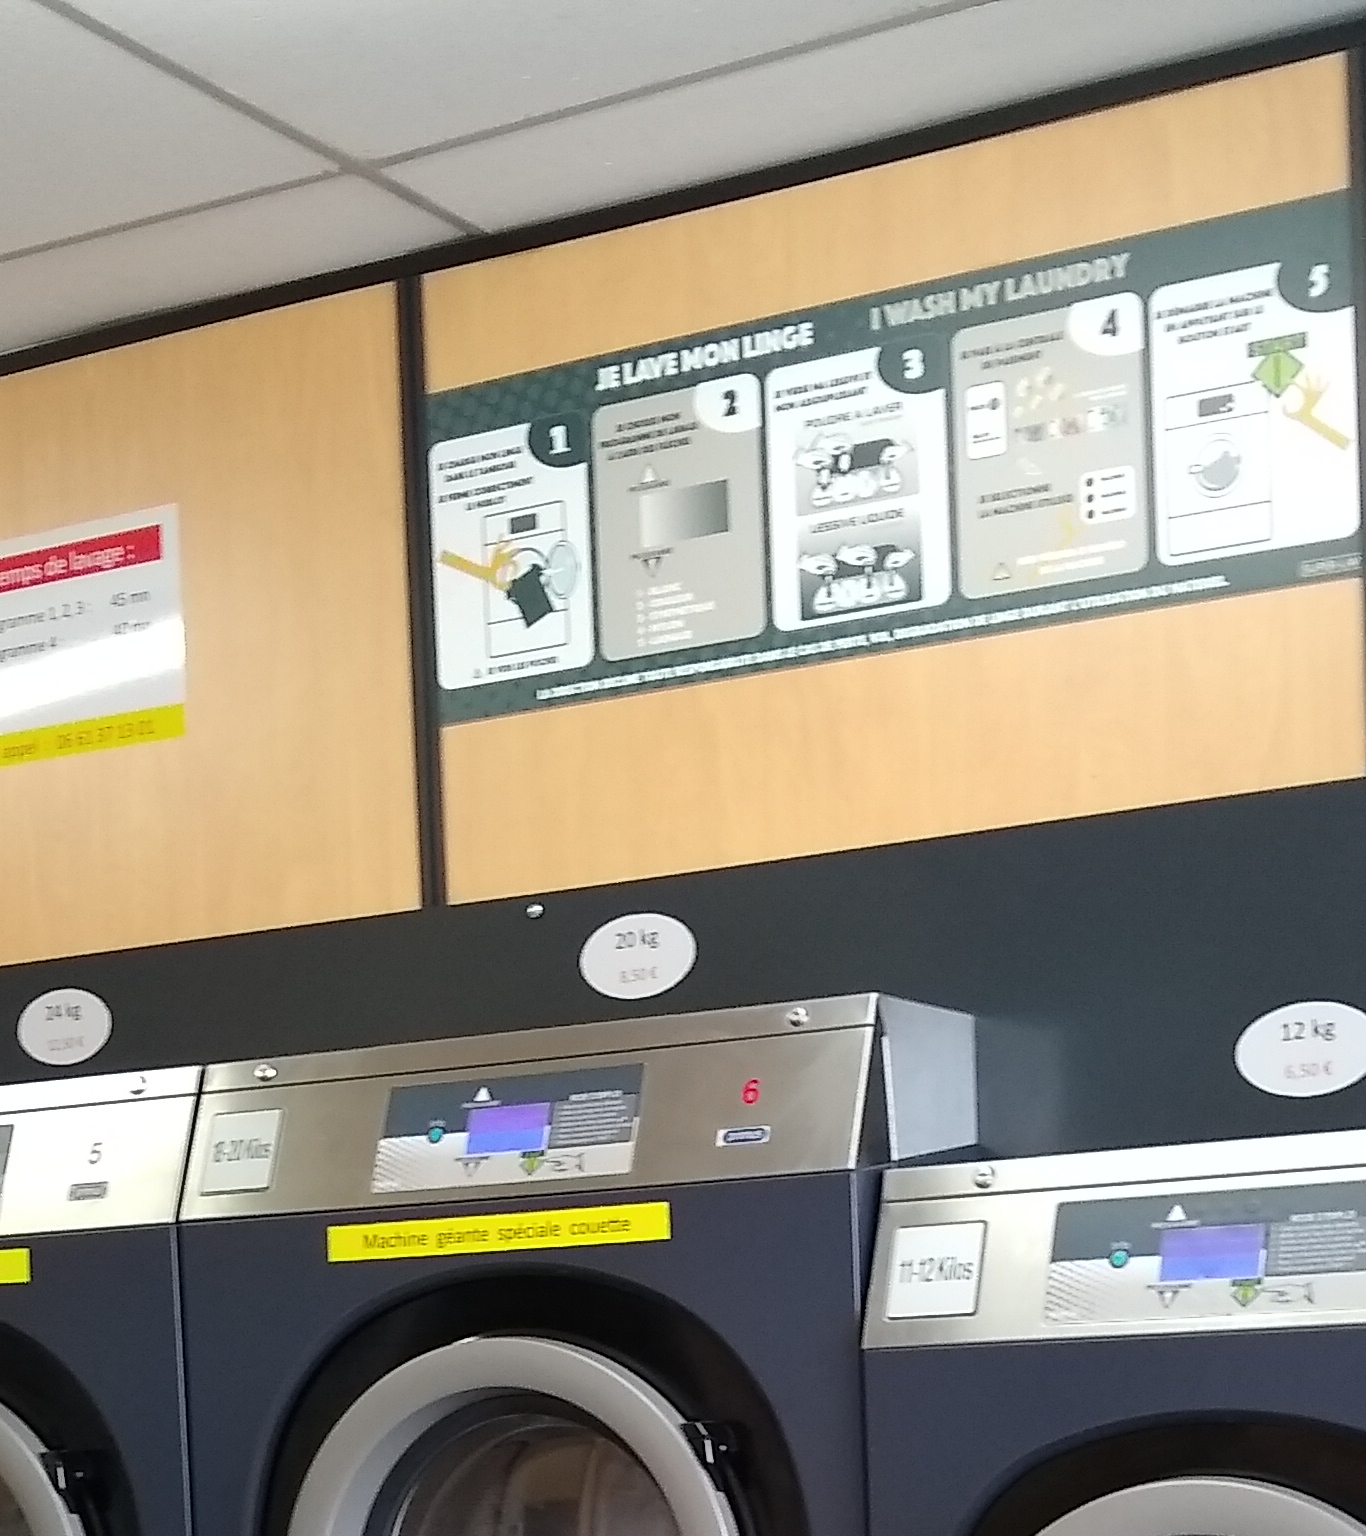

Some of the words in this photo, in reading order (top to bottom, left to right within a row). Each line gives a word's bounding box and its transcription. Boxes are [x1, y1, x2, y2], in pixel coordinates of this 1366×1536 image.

[882, 287, 958, 326] WASH
[959, 276, 1004, 312] MY
[1005, 251, 1132, 301] LAUNDRY
[1307, 263, 1332, 298] 5
[1100, 309, 1121, 337] 4
[594, 363, 621, 391] JE
[621, 348, 678, 386] LAVE
[679, 338, 740, 374] MON
[741, 320, 815, 359] LINGE
[901, 348, 926, 380] 3
[721, 388, 739, 418] 2
[547, 424, 572, 455] 1
[44, 554, 67, 576] de
[69, 545, 126, 570] lavage
[614, 931, 637, 950] 20
[638, 928, 660, 950] kg
[64, 1003, 83, 1023] kg
[1281, 1021, 1306, 1042] 12
[1311, 1018, 1336, 1042] kg
[741, 1077, 760, 1106] 6
[86, 1140, 104, 1165] 5
[363, 1230, 428, 1250] Machine
[436, 1227, 489, 1249] géante
[497, 1220, 562, 1244] spéciale
[568, 1217, 632, 1234] couette
[899, 1257, 934, 1284] 11-12
[936, 1255, 974, 1282] Kilos
